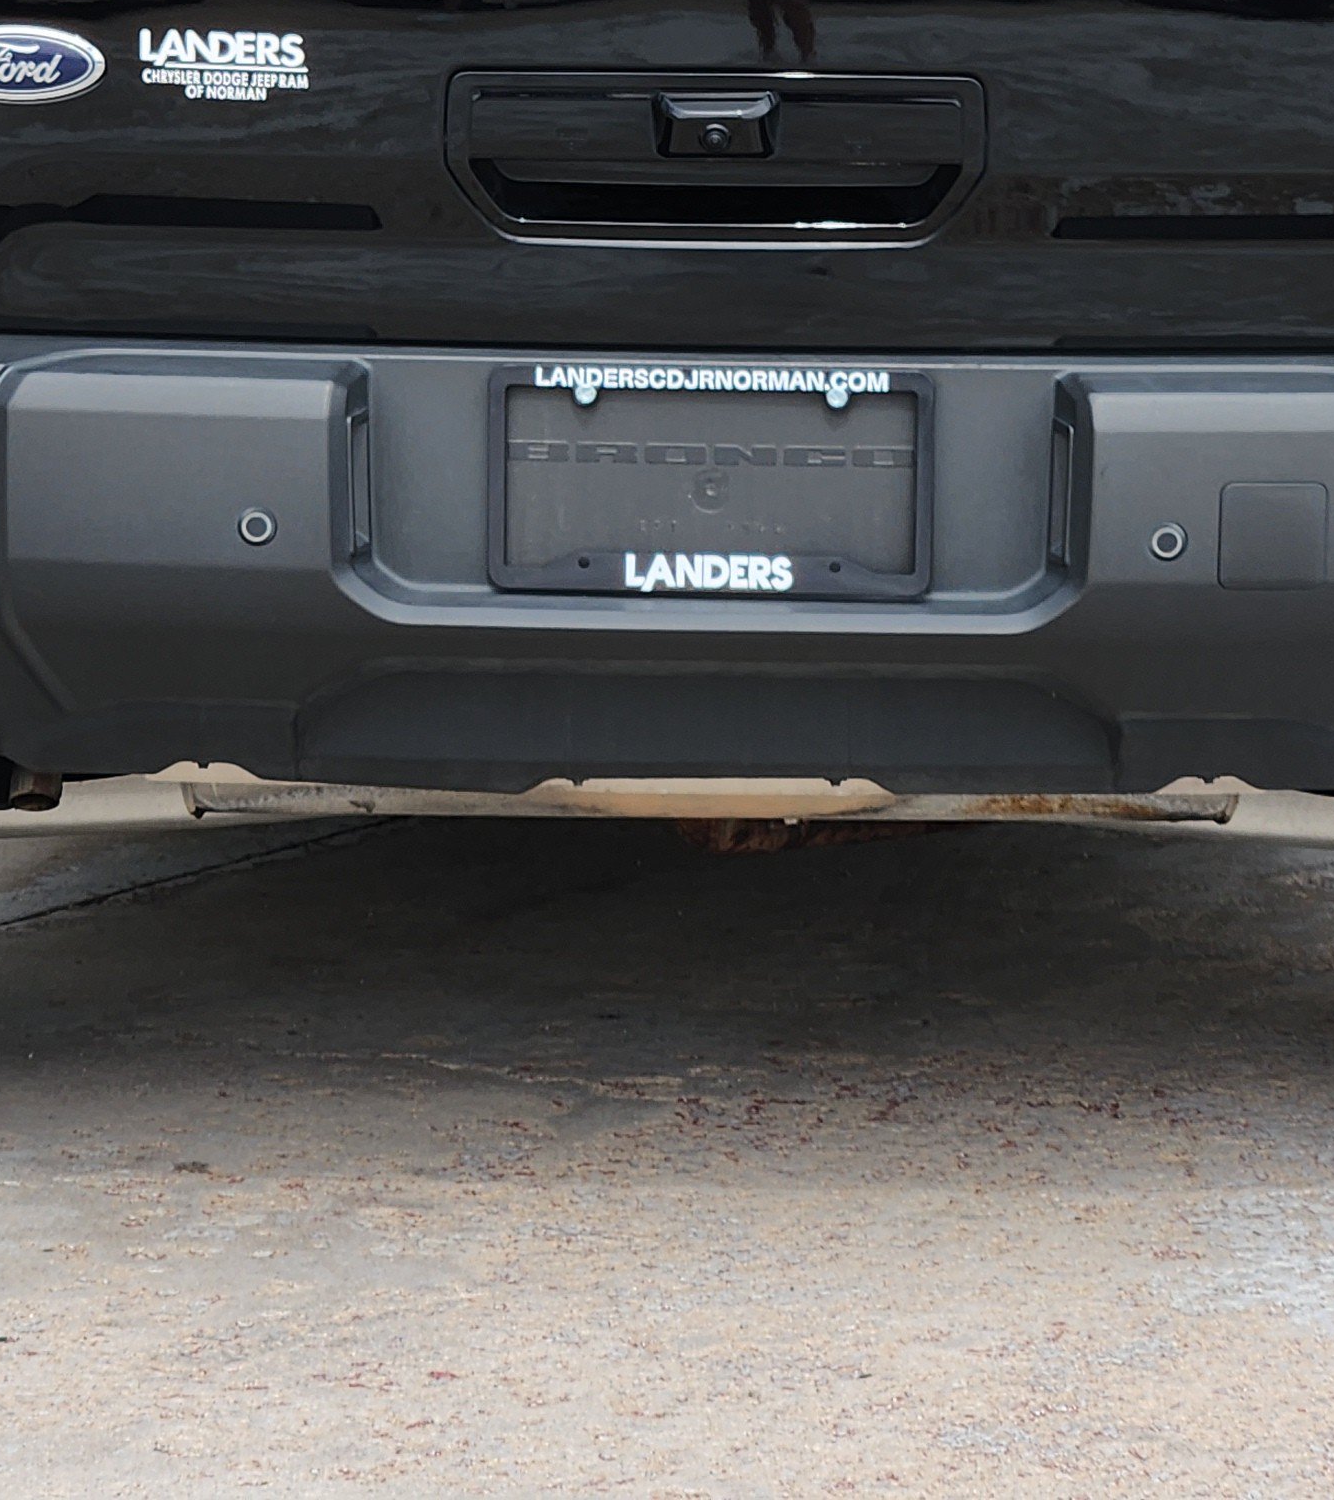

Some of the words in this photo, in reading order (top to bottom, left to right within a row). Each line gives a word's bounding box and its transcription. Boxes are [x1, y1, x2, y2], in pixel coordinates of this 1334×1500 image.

[139, 28, 306, 67] LANDERS
[142, 67, 200, 85] CHRYSLER
[203, 71, 249, 87] DODGE
[184, 85, 204, 100] OF
[206, 86, 267, 101] NORMAN
[535, 366, 890, 393] LANDERSCDJRNORMAN.COM
[508, 439, 915, 468] BRONCO
[625, 552, 793, 593] LANDERS
